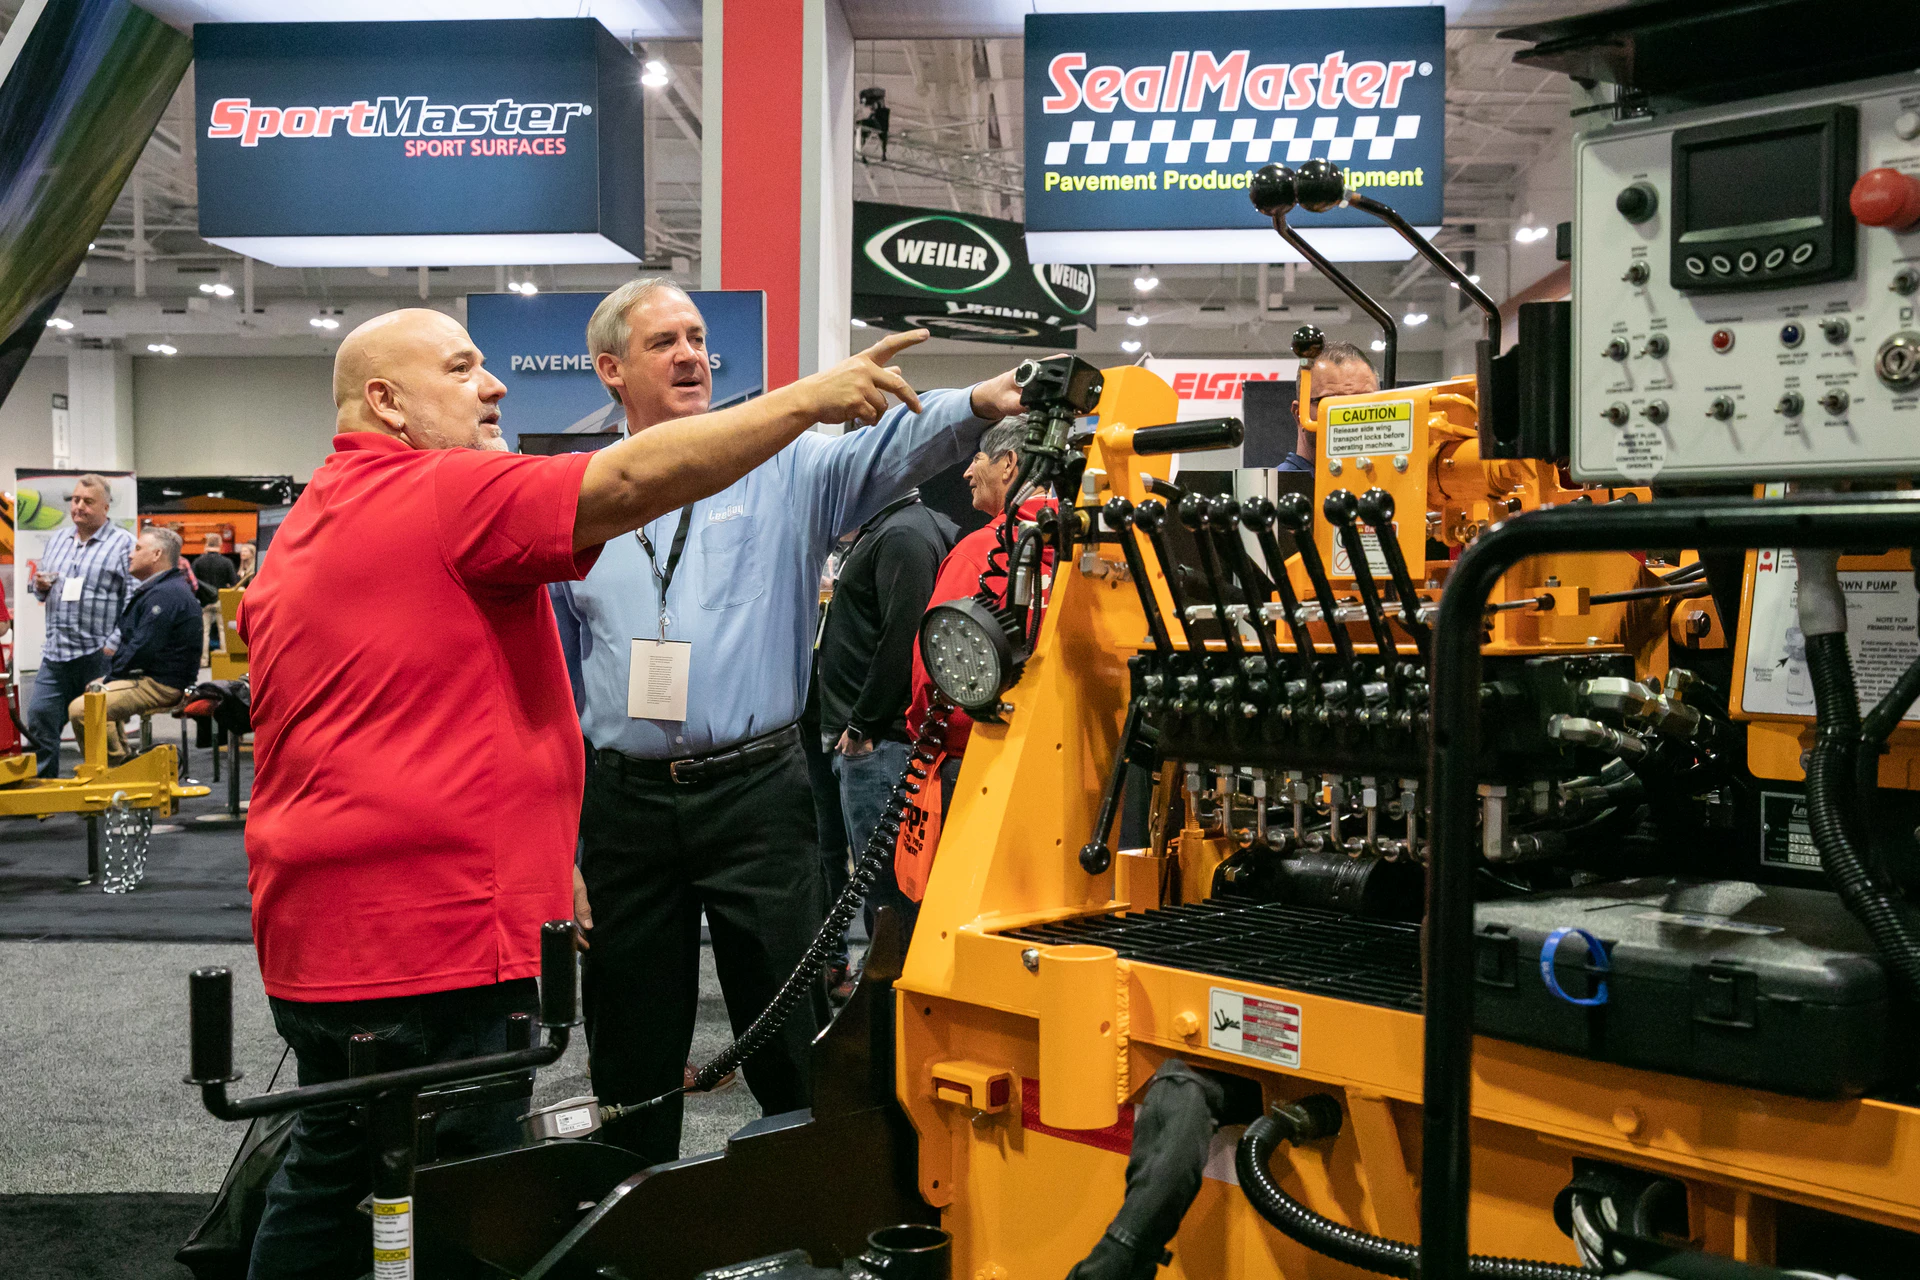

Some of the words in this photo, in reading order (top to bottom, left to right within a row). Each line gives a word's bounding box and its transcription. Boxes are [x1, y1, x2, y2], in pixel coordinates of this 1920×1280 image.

[404, 138, 466, 157] SPORT
[471, 137, 568, 157] SURFACES
[1044, 171, 1158, 192] Pavement
[1163, 169, 1254, 191] Product
[896, 238, 988, 272] WEILER
[1049, 263, 1090, 296] WEILER
[510, 354, 593, 371] PAVEME
[1172, 372, 1279, 400] ELGI
[1342, 406, 1397, 422] CAUTION
[1360, 425, 1374, 433] side
[1375, 424, 1392, 432] wing
[1333, 434, 1363, 443] transport
[1364, 433, 1382, 441] locks
[1383, 431, 1405, 440] before
[1332, 443, 1364, 452] operating
[709, 504, 744, 520] LeeBoy
[1866, 580, 1898, 591] PUMP
